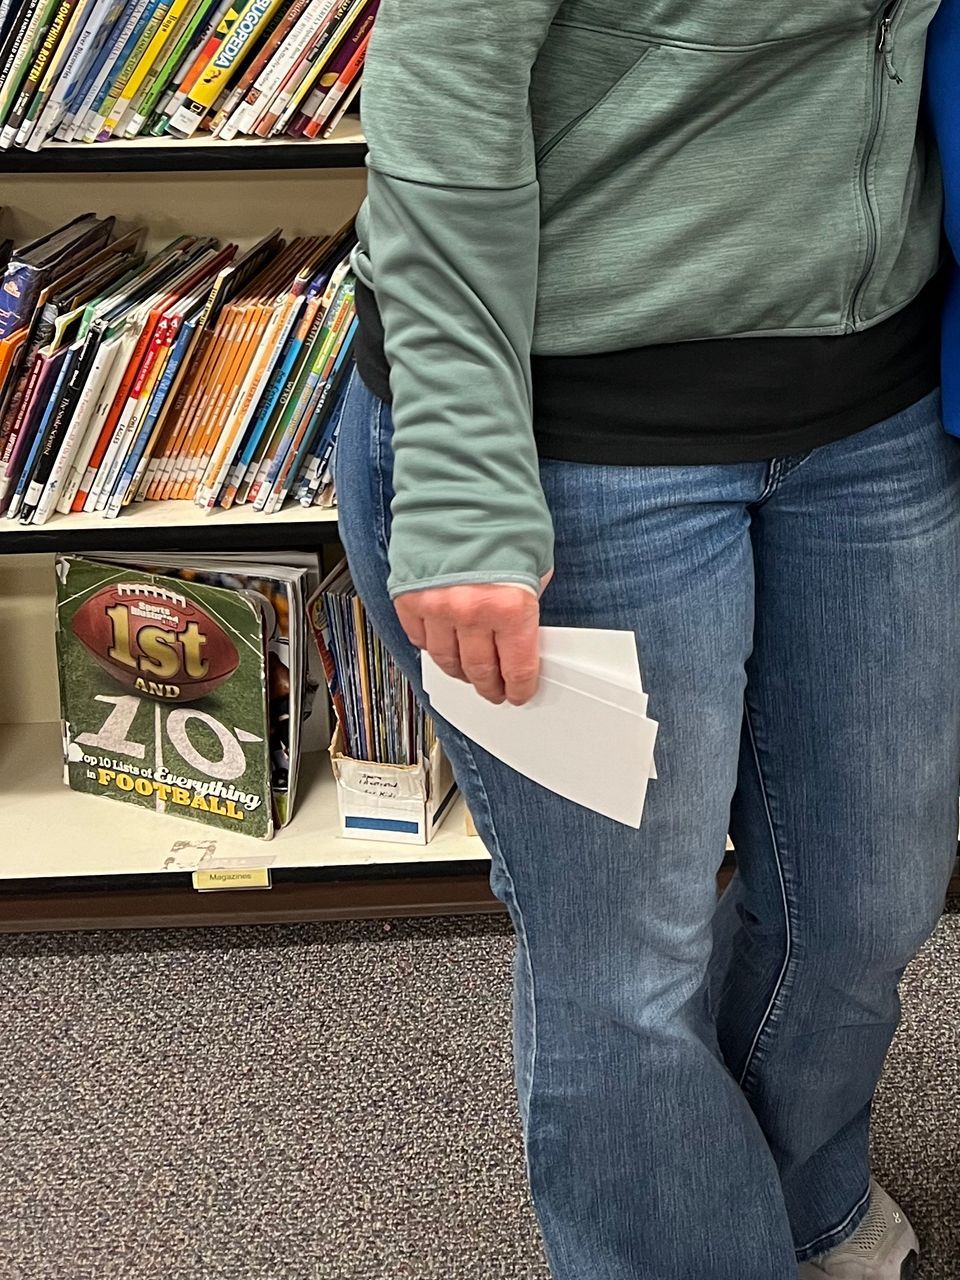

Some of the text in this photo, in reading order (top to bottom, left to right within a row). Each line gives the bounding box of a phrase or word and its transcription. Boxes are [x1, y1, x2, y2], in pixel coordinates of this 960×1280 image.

[9, 17, 29, 54] ENDANGERED
[26, 0, 71, 82] SOMETHING ROTTEN
[107, 10, 139, 64] CREATURES
[159, 12, 178, 35] Bugs
[60, 44, 84, 81] Discoveries
[305, 312, 324, 348] GIRAFFES
[279, 380, 295, 405] WEXO
[40, 396, 71, 456] The Scientist
[112, 423, 126, 445] EAGLES
[127, 416, 139, 435] OWLS
[131, 606, 179, 625] Illustrated
[138, 602, 171, 616] Sports
[105, 603, 209, 681] 1st
[134, 677, 180, 698] AND
[86, 768, 245, 821] in FOOTBALL
[99, 757, 112, 768] 10
[112, 759, 140, 775] Lists
[140, 767, 154, 779] of
[153, 765, 262, 811] Everything
[208, 872, 252, 882] Magazines
